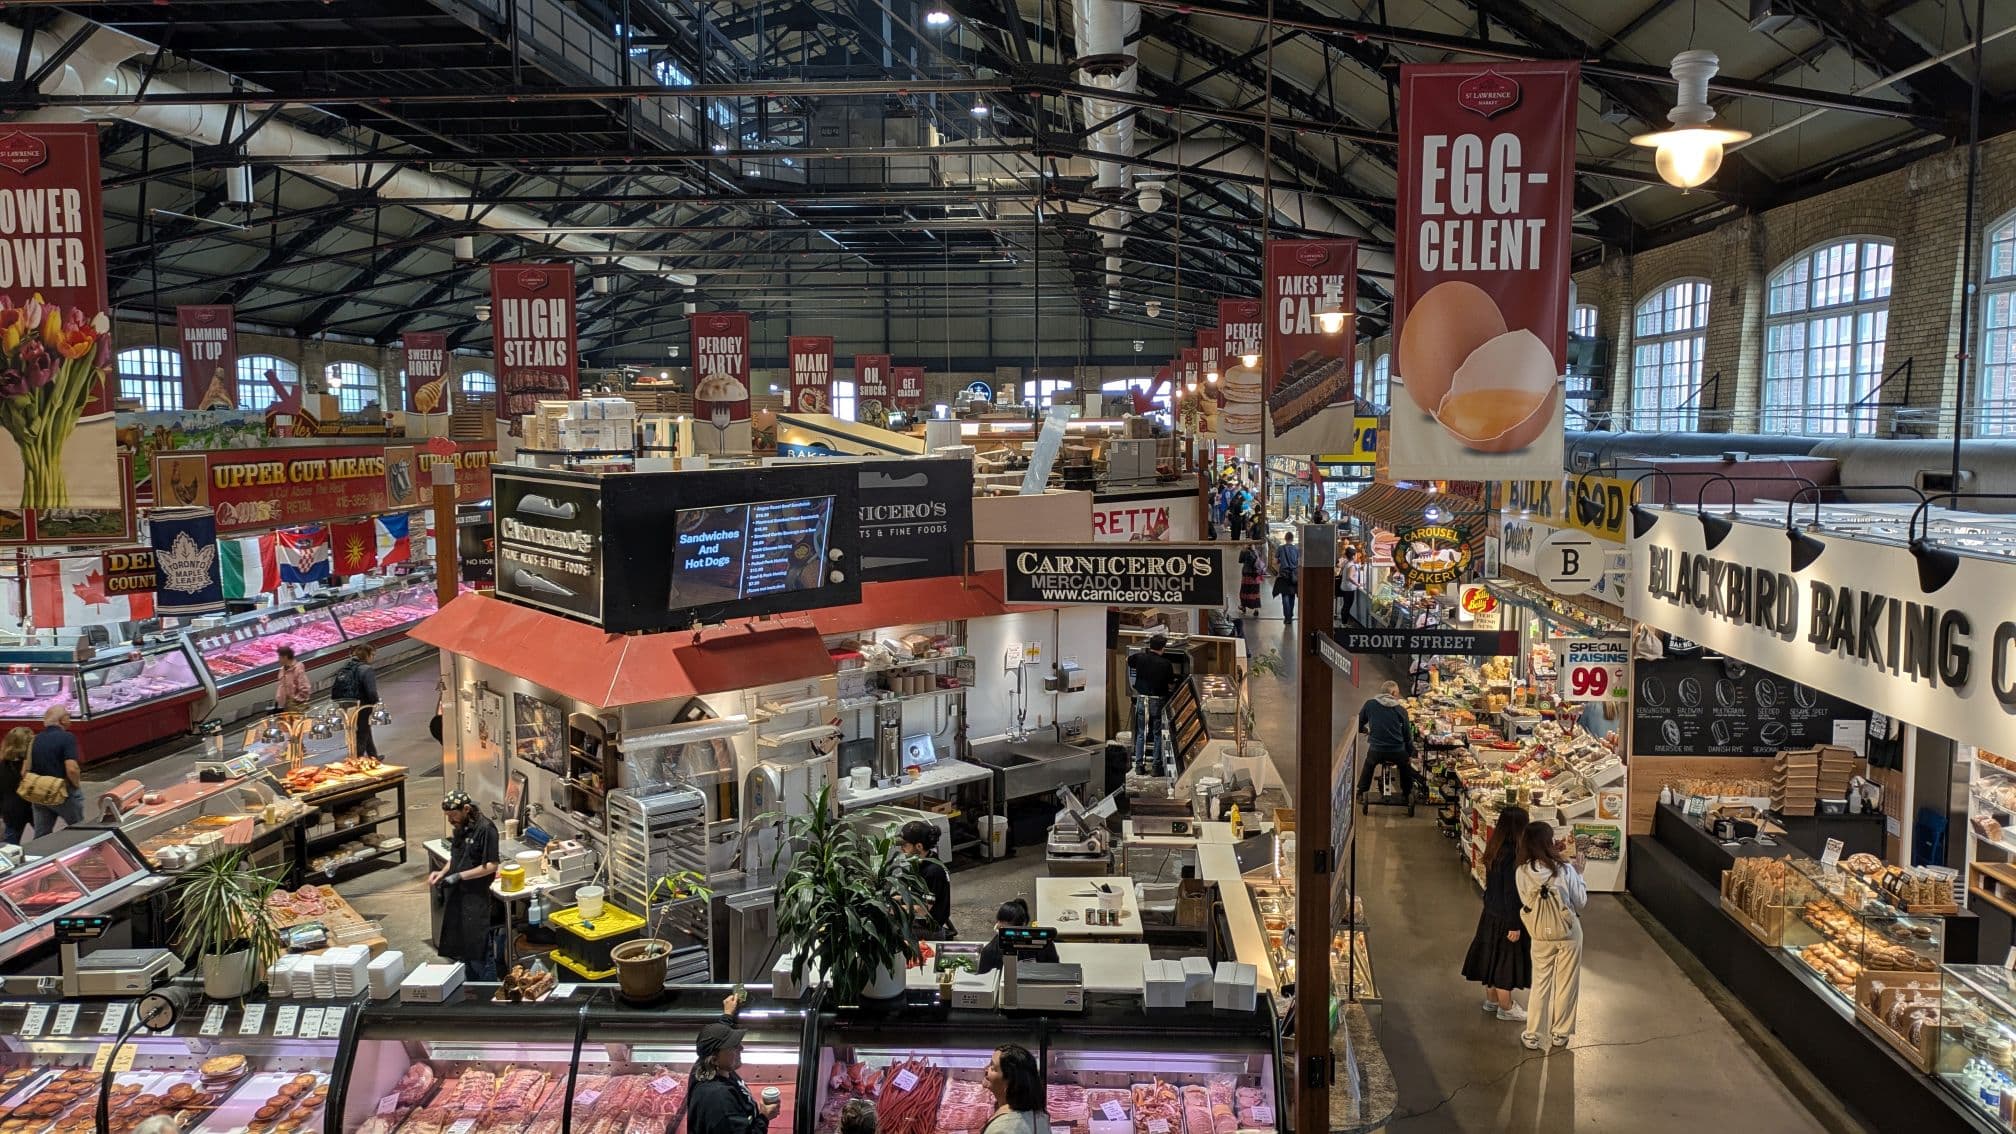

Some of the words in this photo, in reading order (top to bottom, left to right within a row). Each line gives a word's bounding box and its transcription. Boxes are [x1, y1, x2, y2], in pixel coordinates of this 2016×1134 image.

[1474, 91, 1511, 99] LAWRENCE
[1421, 132, 1548, 215] EGG-
[0, 188, 82, 234] OWER
[1419, 219, 1546, 271] CELENT
[0, 238, 87, 288] OWER
[1278, 275, 1317, 295] TAKES
[502, 298, 567, 338] HIGH
[184, 327, 227, 341] HAMMING
[191, 342, 203, 360] IT
[205, 342, 222, 360] UP
[698, 336, 742, 353] PEROGY
[408, 349, 431, 360] SWEET
[432, 349, 442, 360] AS
[504, 340, 567, 367] STEAKS
[408, 361, 441, 376] HONEY
[699, 354, 742, 374] PARTY
[795, 353, 828, 372] MAKI
[795, 373, 809, 385] MY
[812, 373, 827, 384] DAY
[864, 367, 882, 386] OH,
[903, 378, 915, 389] GET
[860, 385, 887, 396] SHUCKS
[464, 451, 488, 469] CUT
[212, 462, 286, 489] UPPER
[289, 459, 327, 483] CUT
[328, 456, 385, 480] MEATS
[1510, 480, 1552, 518] BULK
[859, 501, 947, 520] NICERO'S
[1093, 507, 1169, 535] RETTA
[679, 530, 740, 544] Sandwiches
[890, 527, 911, 536] FINE
[917, 525, 947, 534] FOODS
[1404, 527, 1459, 542] CAROUSEL
[698, 544, 719, 556] And
[168, 560, 206, 571] TORONTO
[685, 559, 704, 569] Hot
[705, 555, 730, 567] Dogs
[1017, 552, 1212, 576] CARNICERO'S
[1561, 549, 1579, 576] B
[1032, 575, 1121, 589] MERCADO
[1130, 577, 1194, 591] LUNCH
[1408, 570, 1457, 583] BAKERY
[1042, 589, 1182, 602] www.carnicero's.ca
[1649, 544, 1799, 640] BLACKBIRD
[1808, 580, 1972, 690] BAKING
[1349, 635, 1405, 648] FRONT
[1410, 635, 1476, 649] STREET
[1569, 642, 1627, 652] SPECIAL
[1569, 653, 1627, 663] RAISINS
[1572, 666, 1608, 697] 99
